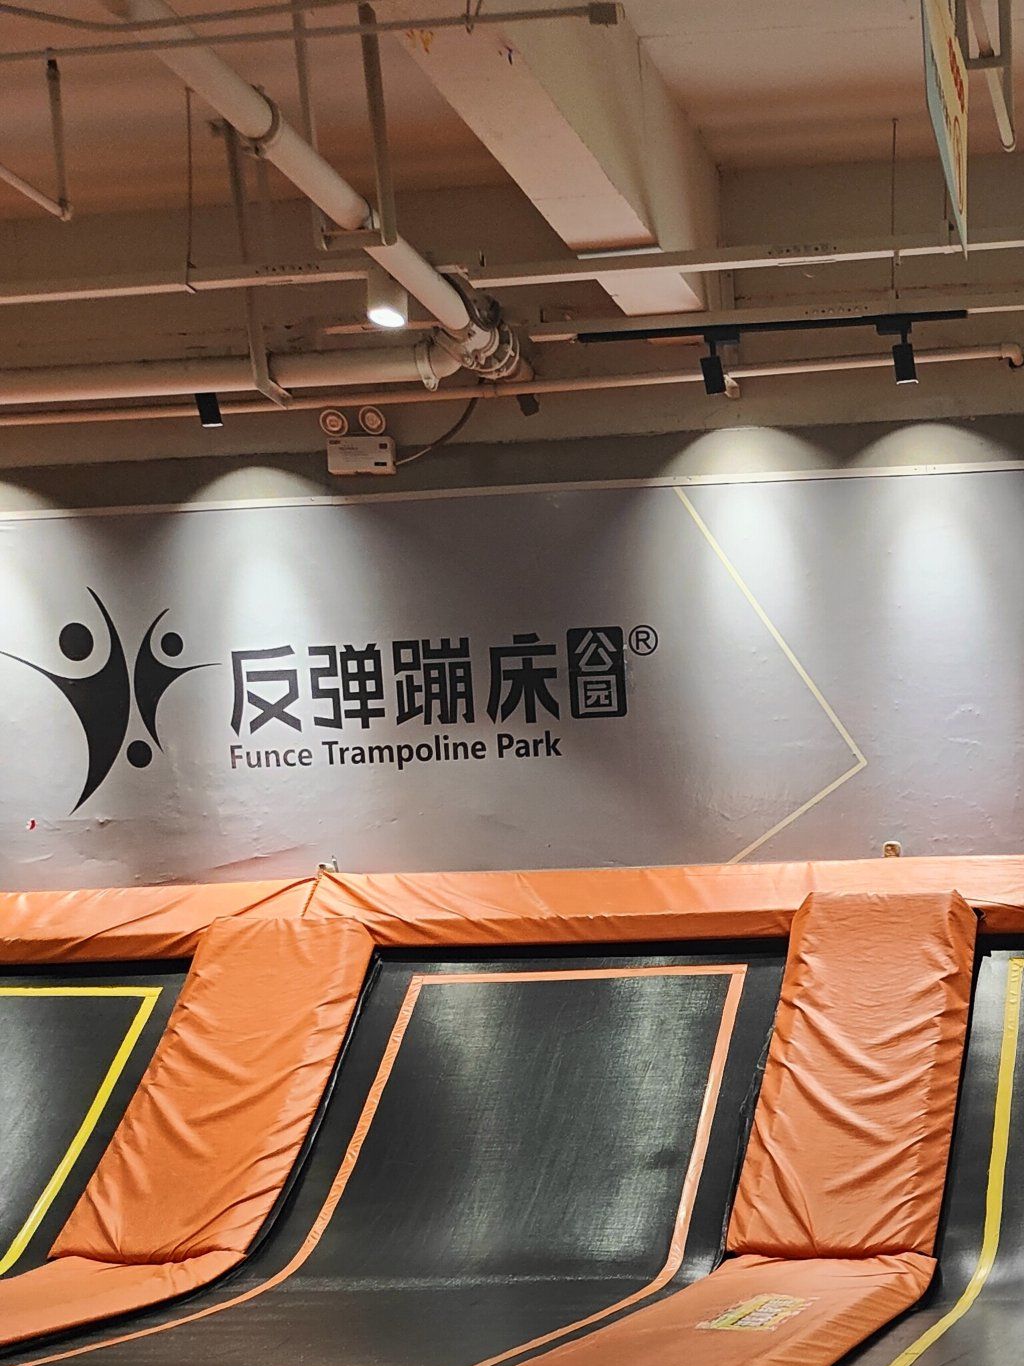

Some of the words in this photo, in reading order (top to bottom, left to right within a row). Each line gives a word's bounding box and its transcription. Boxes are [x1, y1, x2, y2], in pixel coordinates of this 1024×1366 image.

[230, 743, 313, 770] Funce
[322, 735, 487, 771] Trampoline
[497, 731, 562, 760] Park
